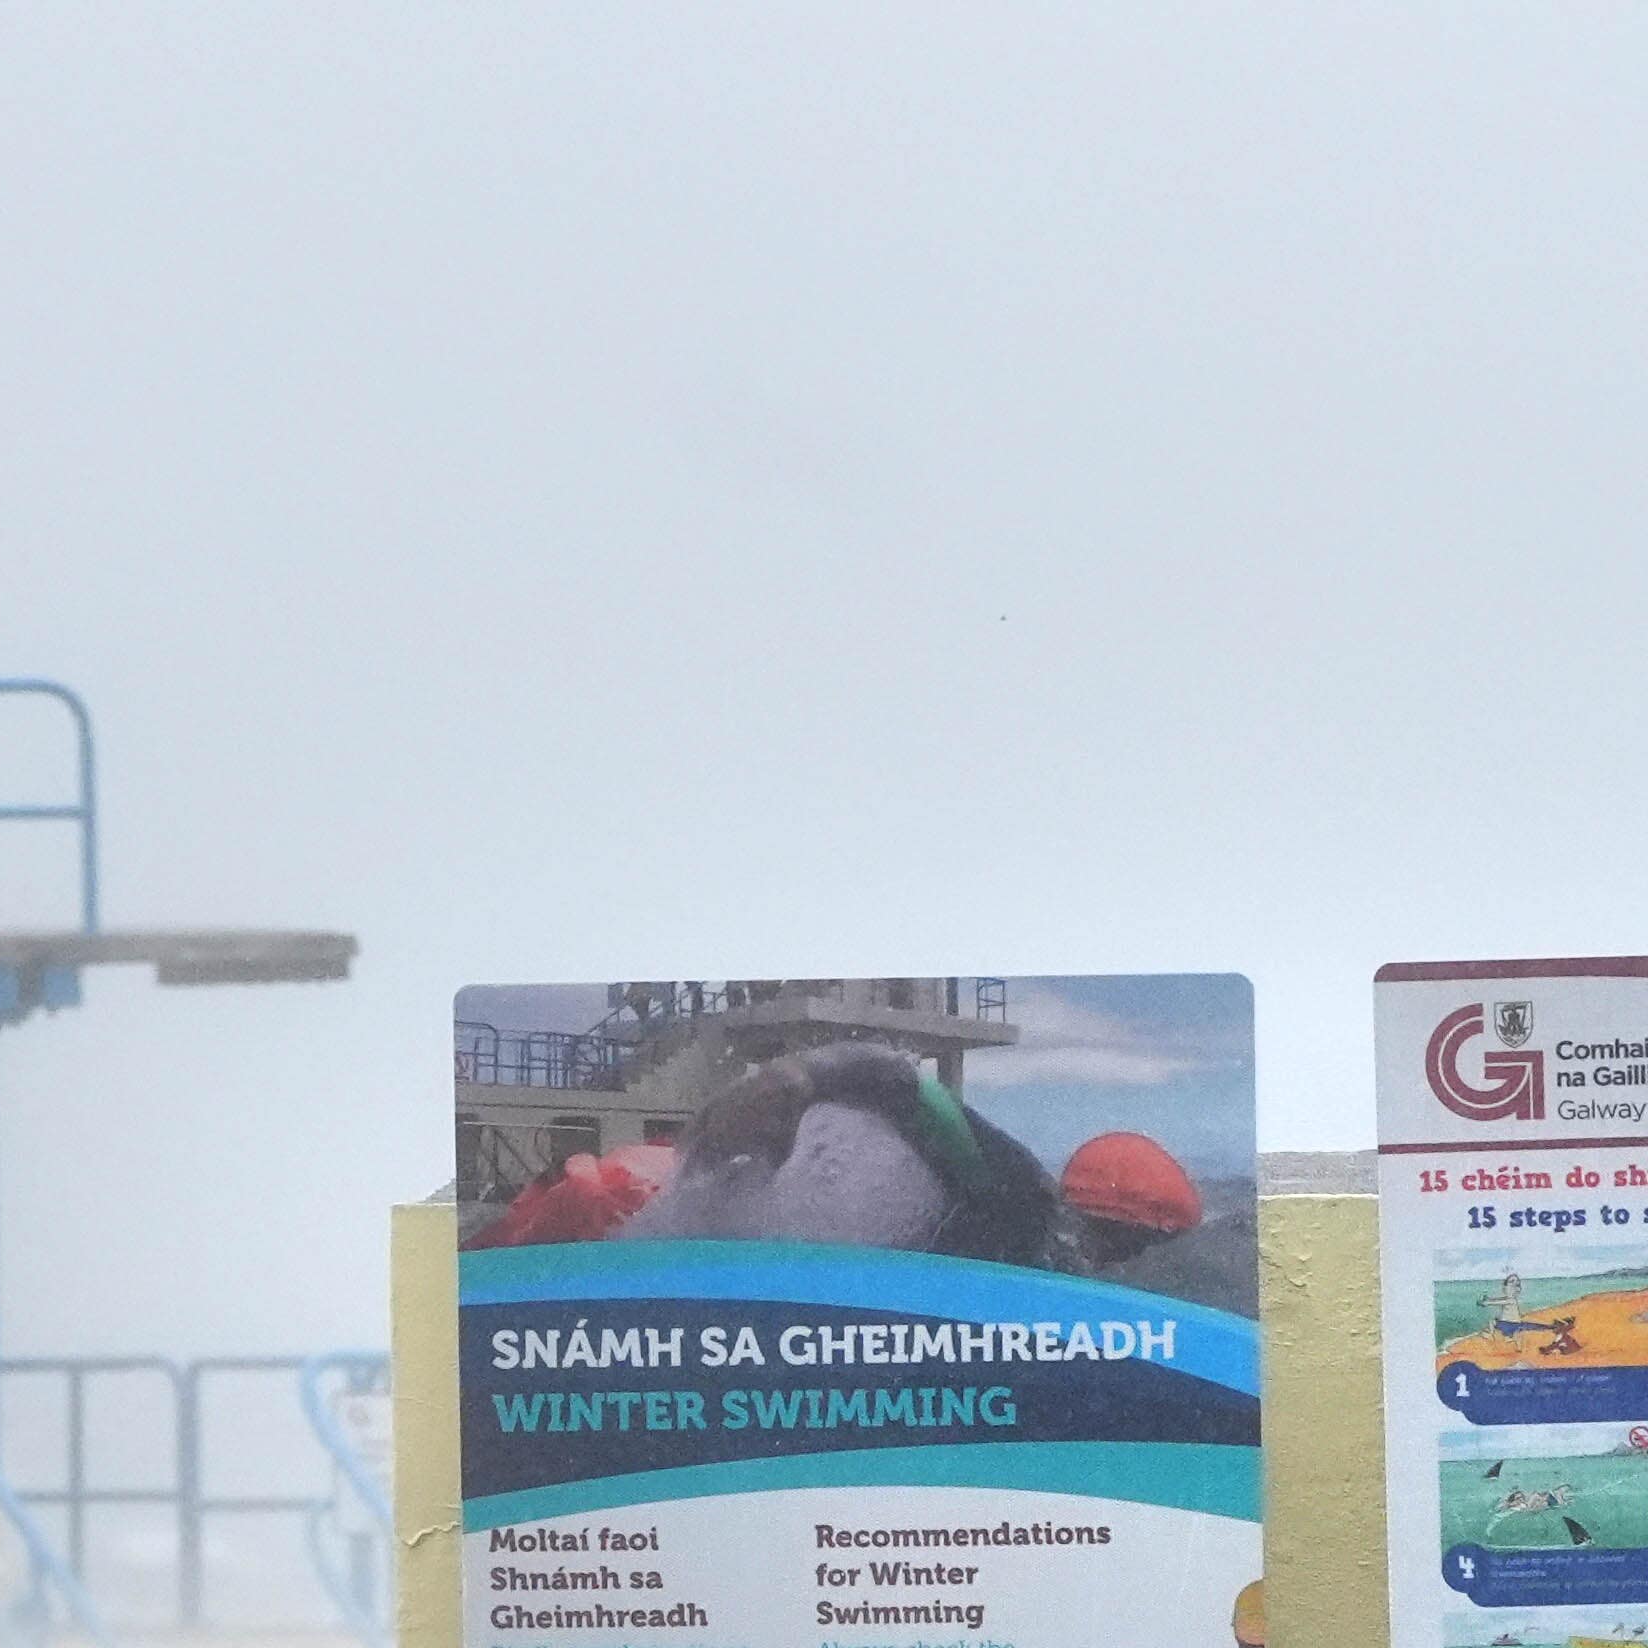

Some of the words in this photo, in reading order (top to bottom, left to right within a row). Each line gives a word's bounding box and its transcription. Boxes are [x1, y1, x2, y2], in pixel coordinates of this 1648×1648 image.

[1557, 1072, 1585, 1087] na
[1558, 1100, 1647, 1122] Galway
[1420, 1170, 1448, 1192] 15
[1462, 1167, 1552, 1190] chéim
[1566, 1166, 1600, 1188] do
[1468, 1206, 1496, 1228] 15
[1510, 1208, 1586, 1232] steps
[1600, 1205, 1630, 1225] to
[493, 1322, 683, 1367] SNÁMH
[701, 1328, 765, 1365] SA
[780, 1321, 1177, 1363] GHEIMHREADH
[1455, 1374, 1469, 1397] 1
[492, 1392, 706, 1431] WINTER
[722, 1388, 1017, 1428] SWIMMING
[490, 1527, 589, 1553] Moltaí
[598, 1528, 659, 1551] faoi
[815, 1523, 1111, 1547] Recommendations
[490, 1566, 621, 1590] Shnámh
[630, 1572, 663, 1589] sa
[816, 1563, 861, 1586] for
[869, 1562, 979, 1585] Winter
[1459, 1556, 1475, 1579] 4
[490, 1604, 708, 1629] Gheimhreadh
[816, 1601, 985, 1629] Swimming
